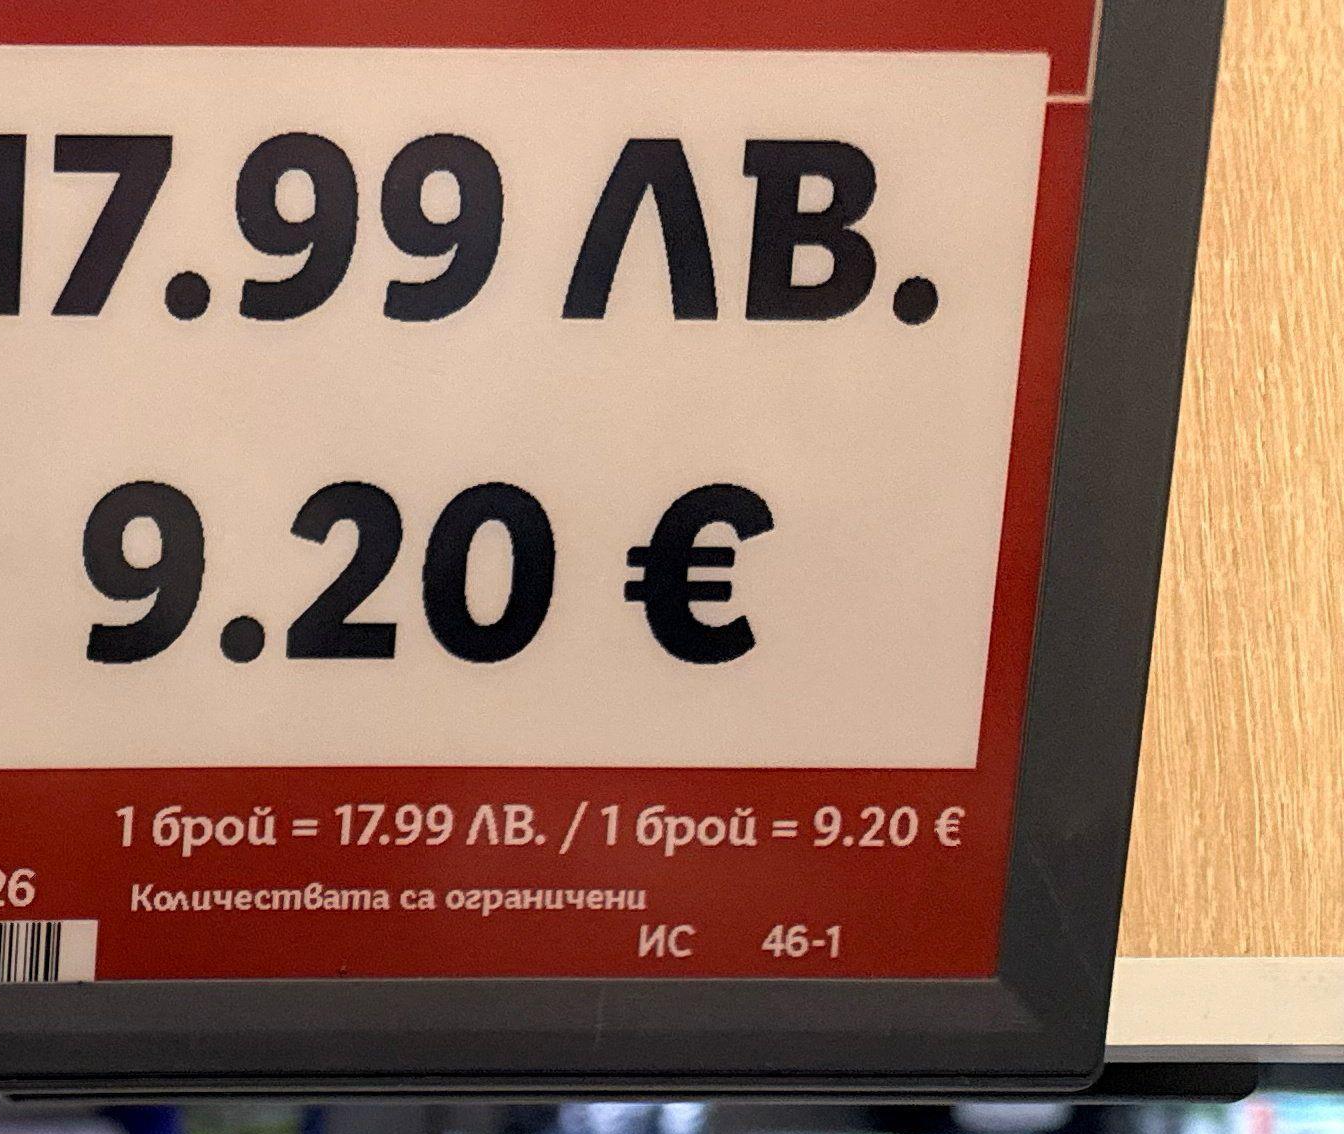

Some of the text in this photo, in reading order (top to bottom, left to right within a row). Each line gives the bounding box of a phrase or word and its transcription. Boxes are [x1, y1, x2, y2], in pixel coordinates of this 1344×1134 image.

[560, 137, 939, 326] ЛВ.
[82, 479, 775, 666] 9.20 €
[116, 801, 965, 857] 1 брой = 17.99 ЛВ. / 1 брой = 9.20 €
[131, 882, 646, 917] Количествата са ограничени
[639, 924, 840, 958] ИС 46-1
